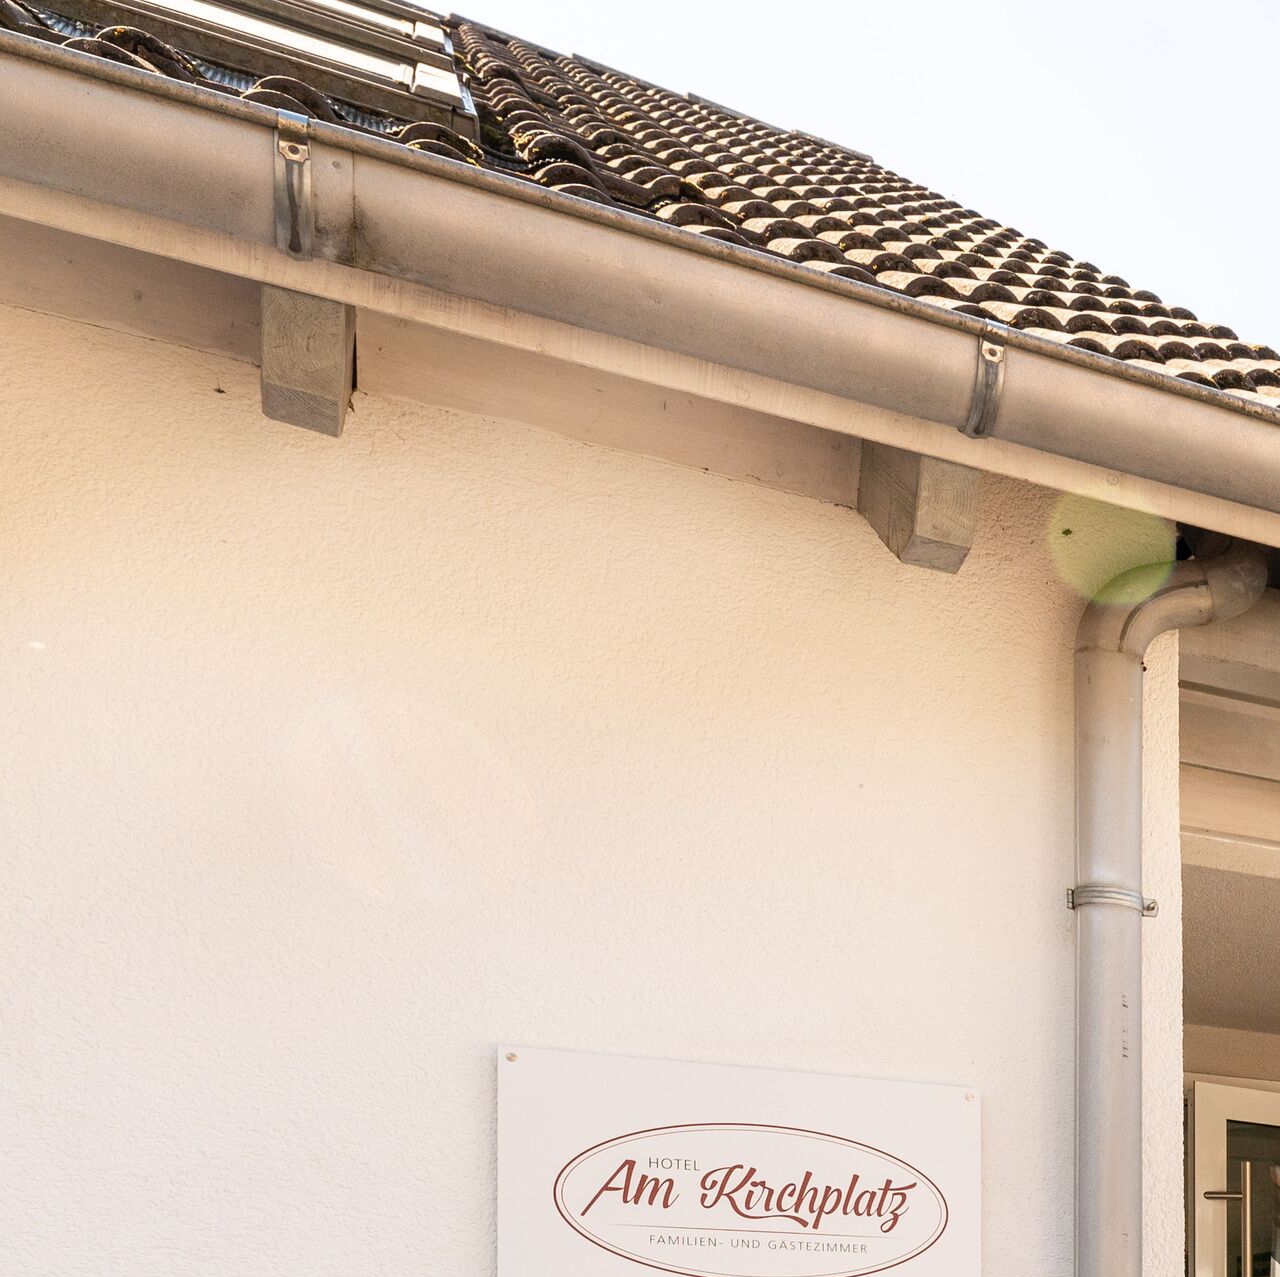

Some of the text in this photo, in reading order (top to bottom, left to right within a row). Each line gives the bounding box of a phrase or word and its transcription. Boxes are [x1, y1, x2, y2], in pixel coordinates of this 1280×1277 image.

[647, 1156, 701, 1172] HOTEL
[580, 1158, 918, 1234] Am Kirchplatz
[648, 1233, 868, 1254] FAMILIEN- UND GÄSTEZIMMER
